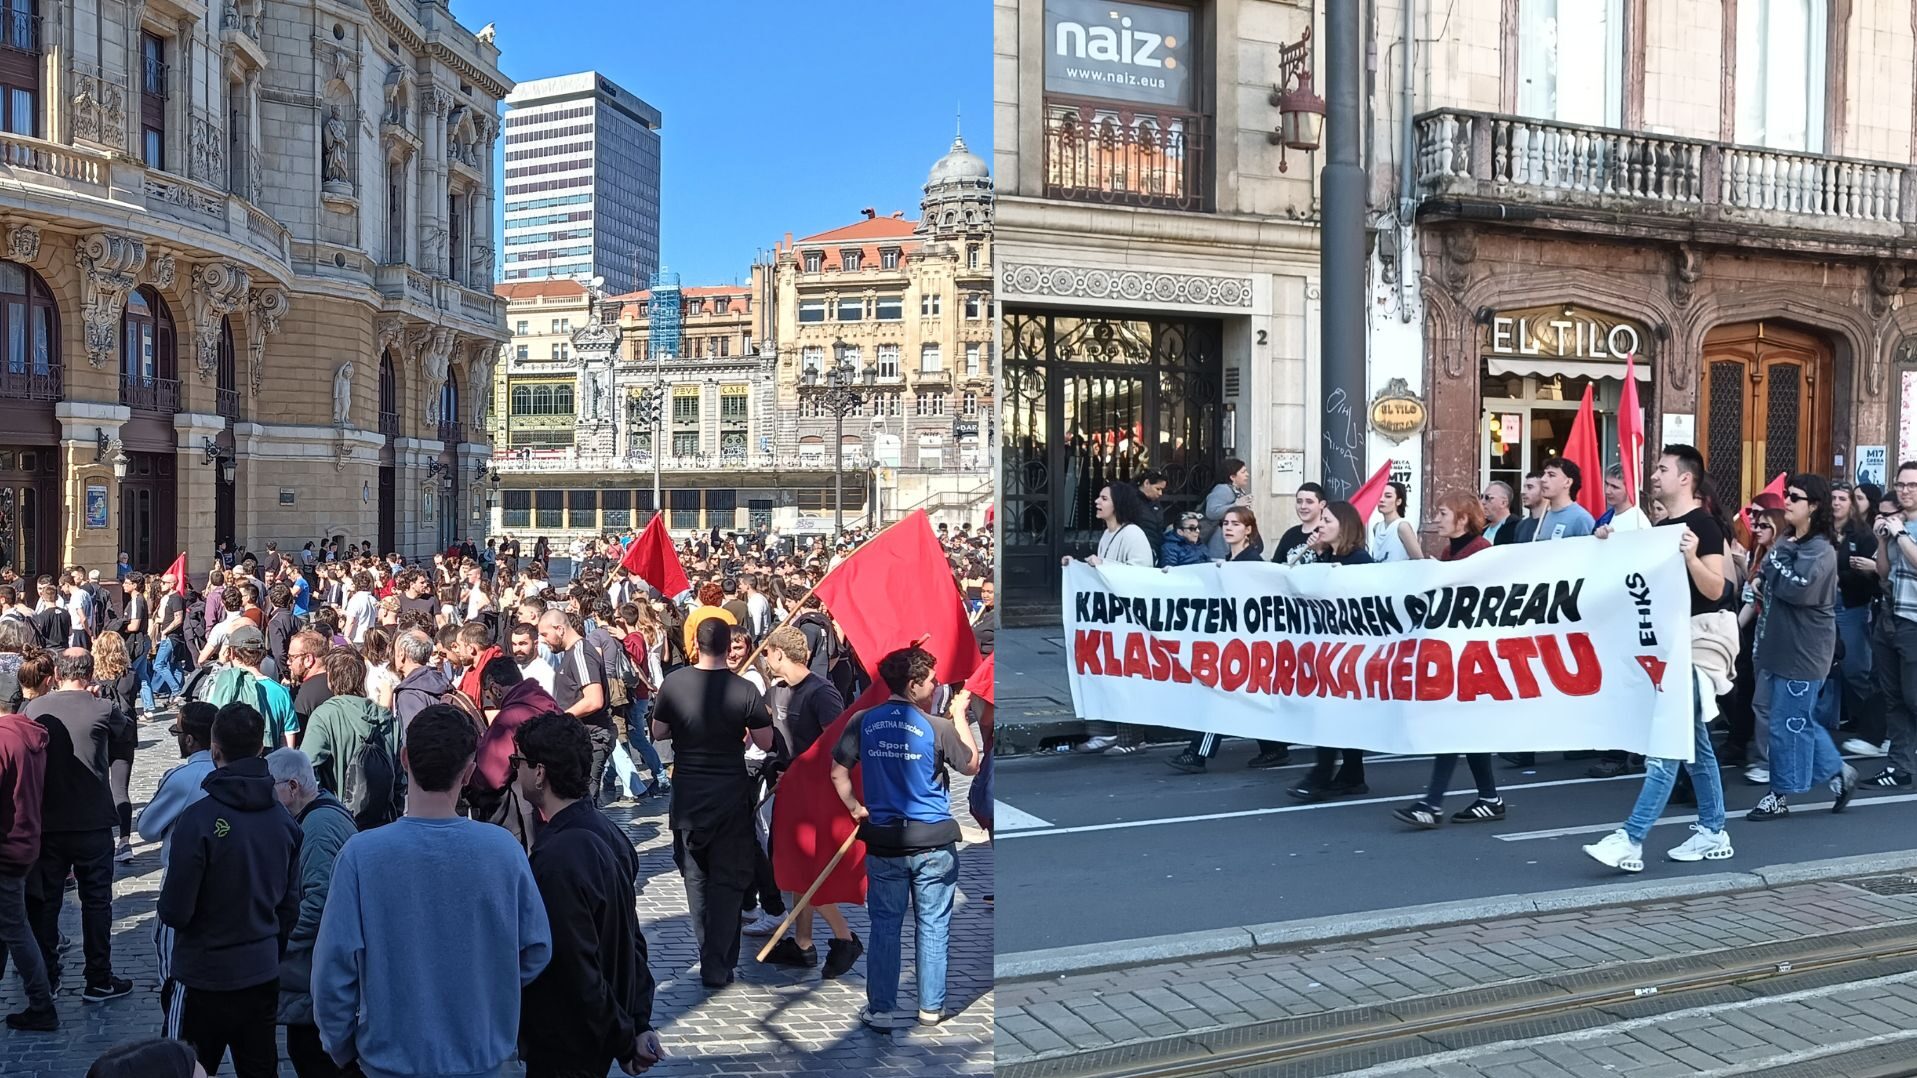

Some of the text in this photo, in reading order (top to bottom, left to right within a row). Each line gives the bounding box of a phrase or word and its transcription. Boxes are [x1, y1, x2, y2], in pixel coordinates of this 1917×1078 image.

[1066, 67, 1166, 89] www.naiz.eus
[1101, 327, 1109, 339] 2
[1256, 330, 1268, 345] 2
[1493, 316, 1639, 359] EL TILO
[1866, 449, 1884, 458] M17
[1388, 472, 1412, 482] M17
[1243, 595, 1404, 637] OFENTSIBAREN
[1404, 578, 1585, 633] DURREAN
[1625, 572, 1658, 646] EHKS
[1191, 638, 1366, 701] BORROKA
[1364, 632, 1603, 702] HEDATU
[872, 720, 897, 730] HERTHA
[878, 740, 909, 750] Sport
[868, 749, 923, 760] Grünberger
